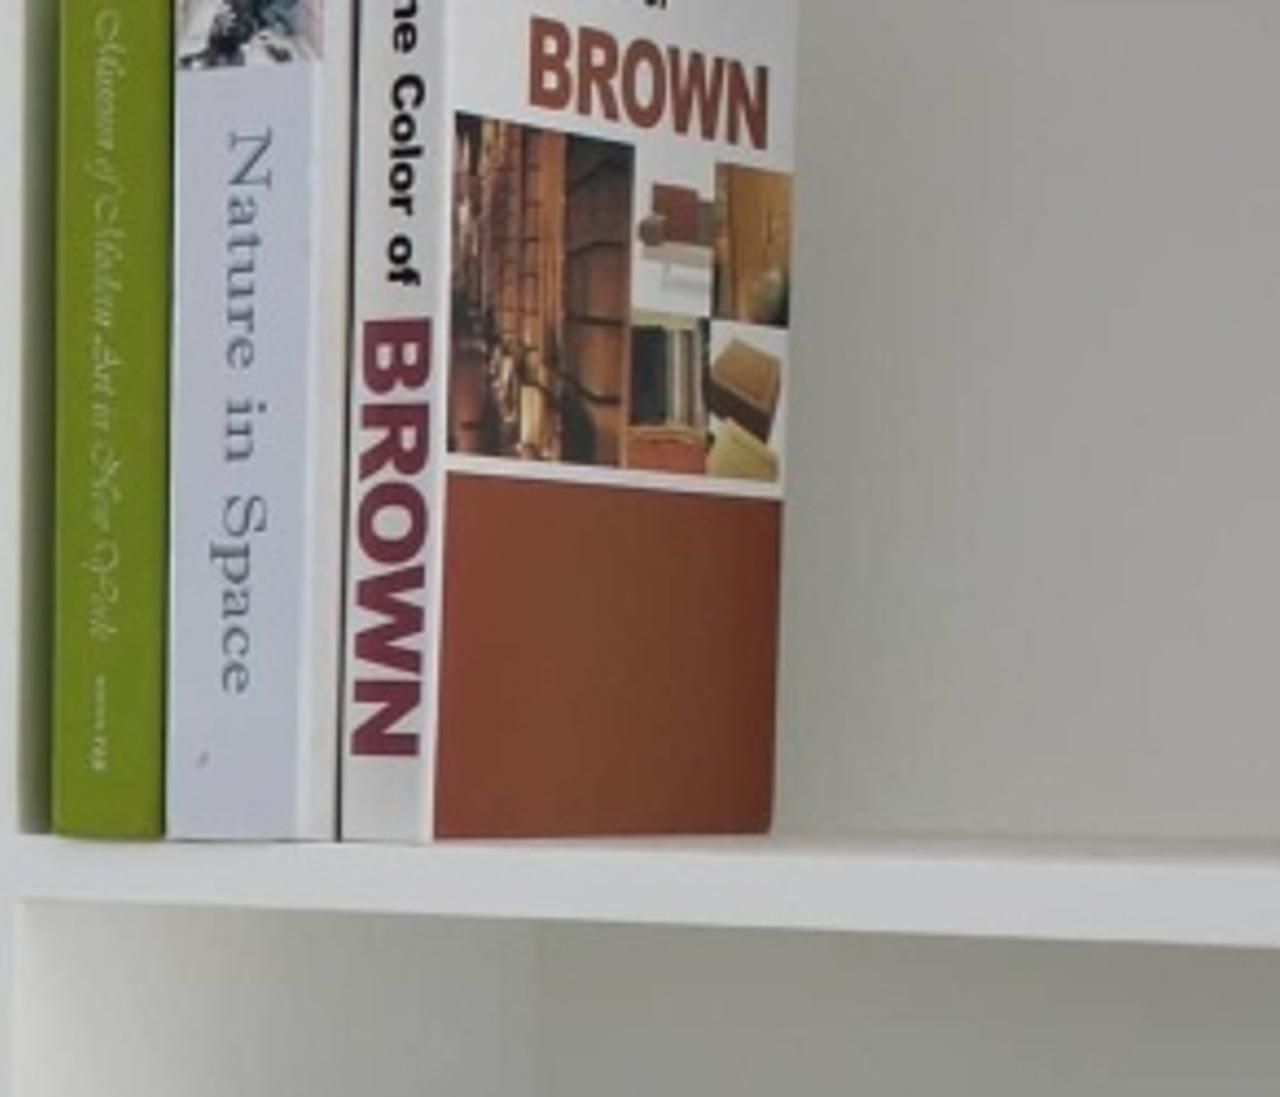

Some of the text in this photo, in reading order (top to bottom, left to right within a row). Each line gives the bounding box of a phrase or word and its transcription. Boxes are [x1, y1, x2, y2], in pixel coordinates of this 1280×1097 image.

[387, 75, 426, 217] Color
[528, 14, 769, 151] BROWN
[387, 236, 423, 286] of
[210, 131, 273, 695] Nature in Space
[350, 317, 433, 758] BROWN
